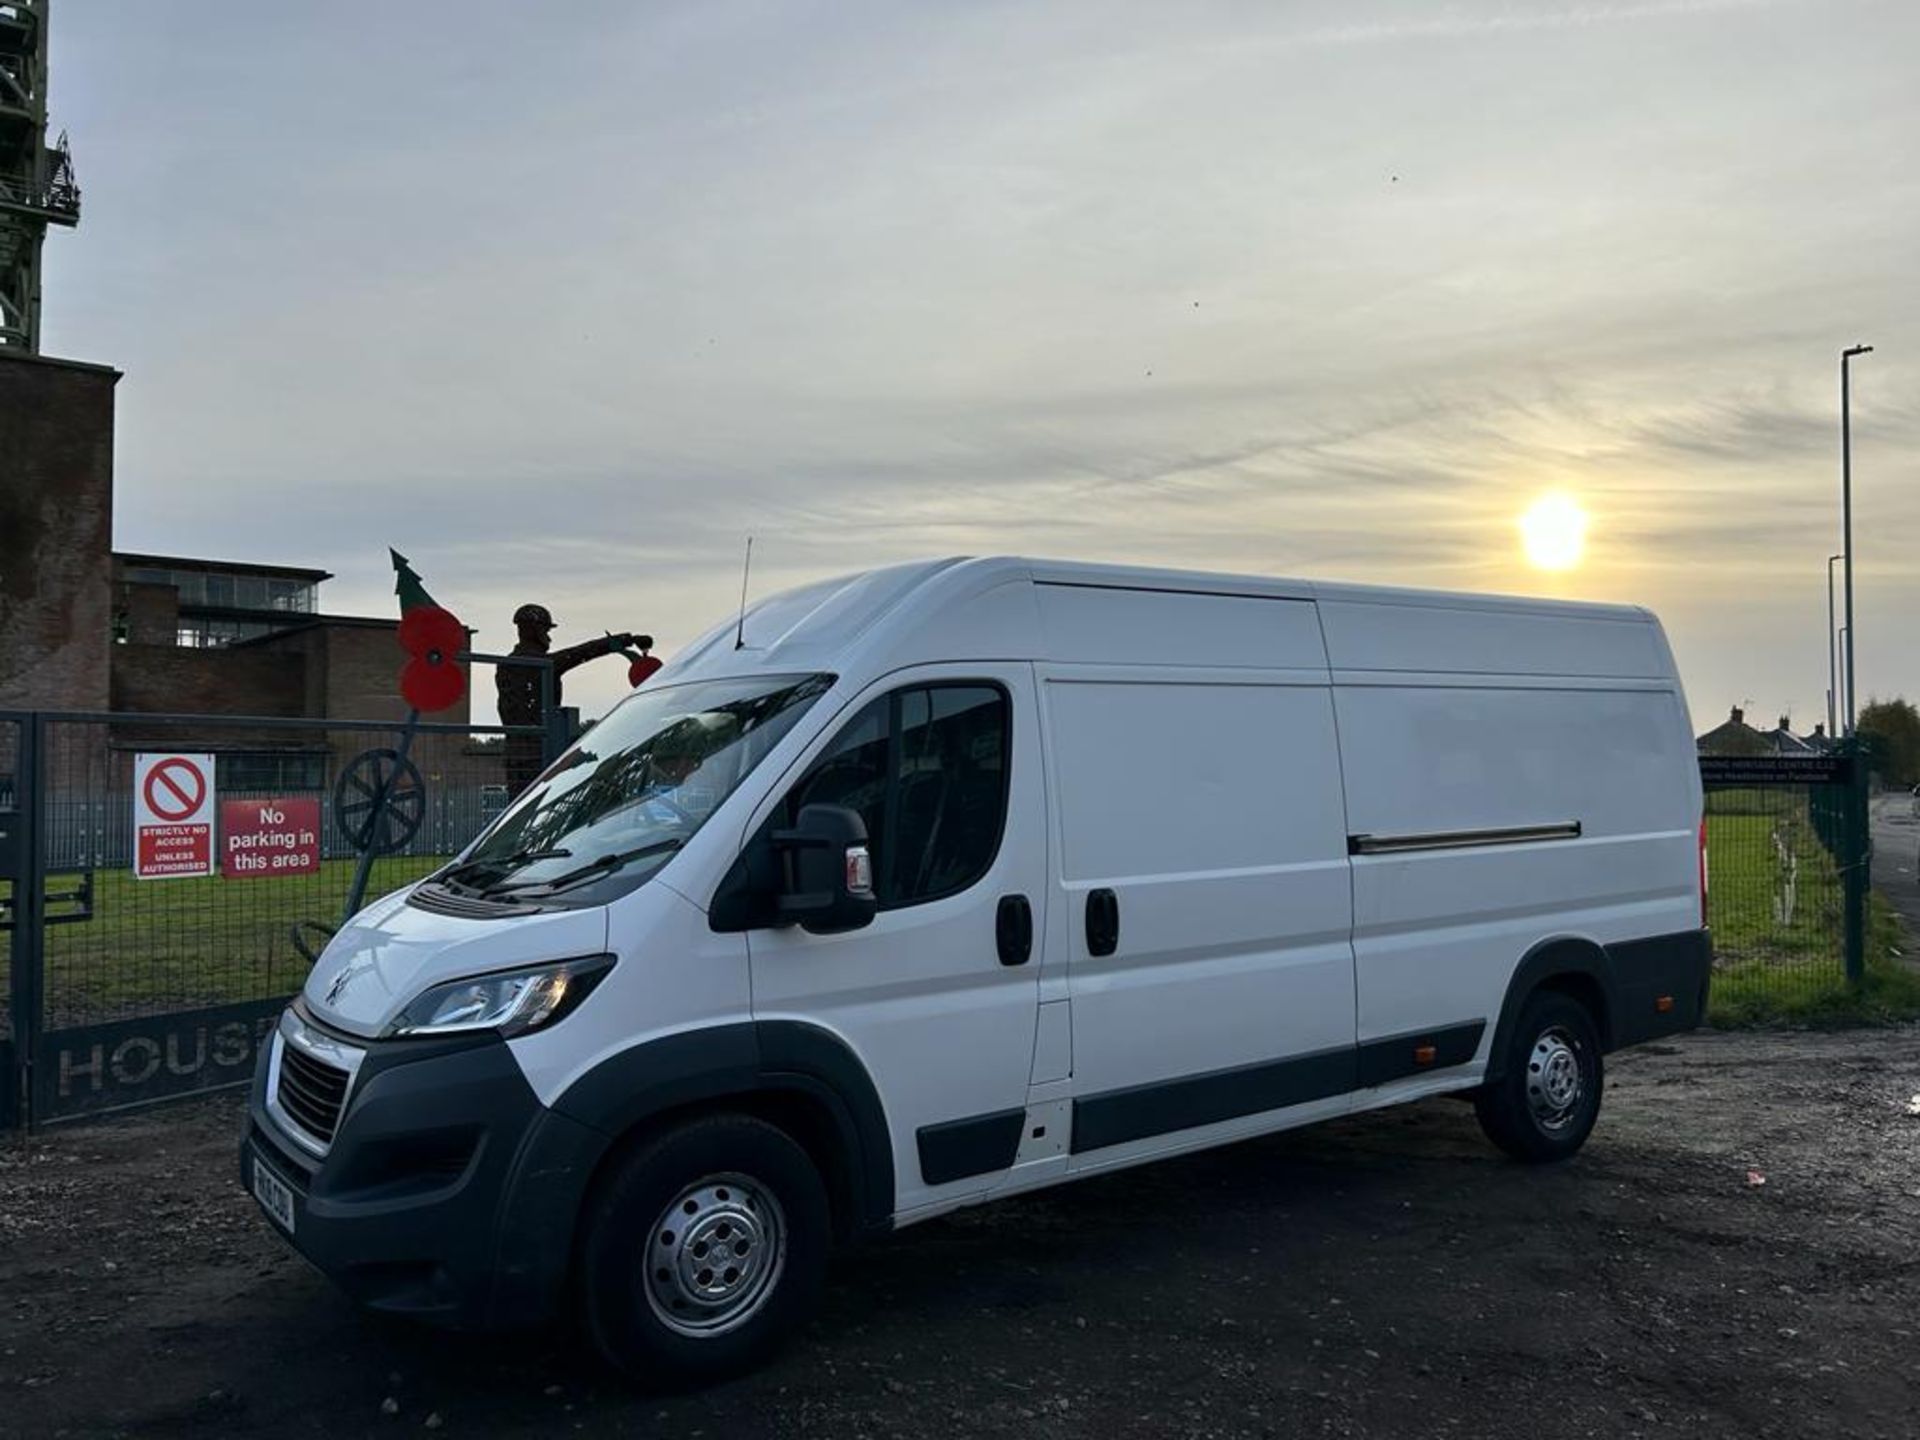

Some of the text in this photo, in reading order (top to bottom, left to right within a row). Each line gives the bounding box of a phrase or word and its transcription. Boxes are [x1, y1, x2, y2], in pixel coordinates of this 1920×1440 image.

[1778, 760, 1813, 770] CENTRE
[260, 807, 285, 825] No
[142, 826, 207, 836] STRICTLY NO
[155, 837, 195, 847] ACCESS
[229, 828, 314, 852] parking in
[155, 851, 194, 861] UNLESS
[234, 853, 310, 870] this area
[142, 862, 207, 873] AUTHORISED
